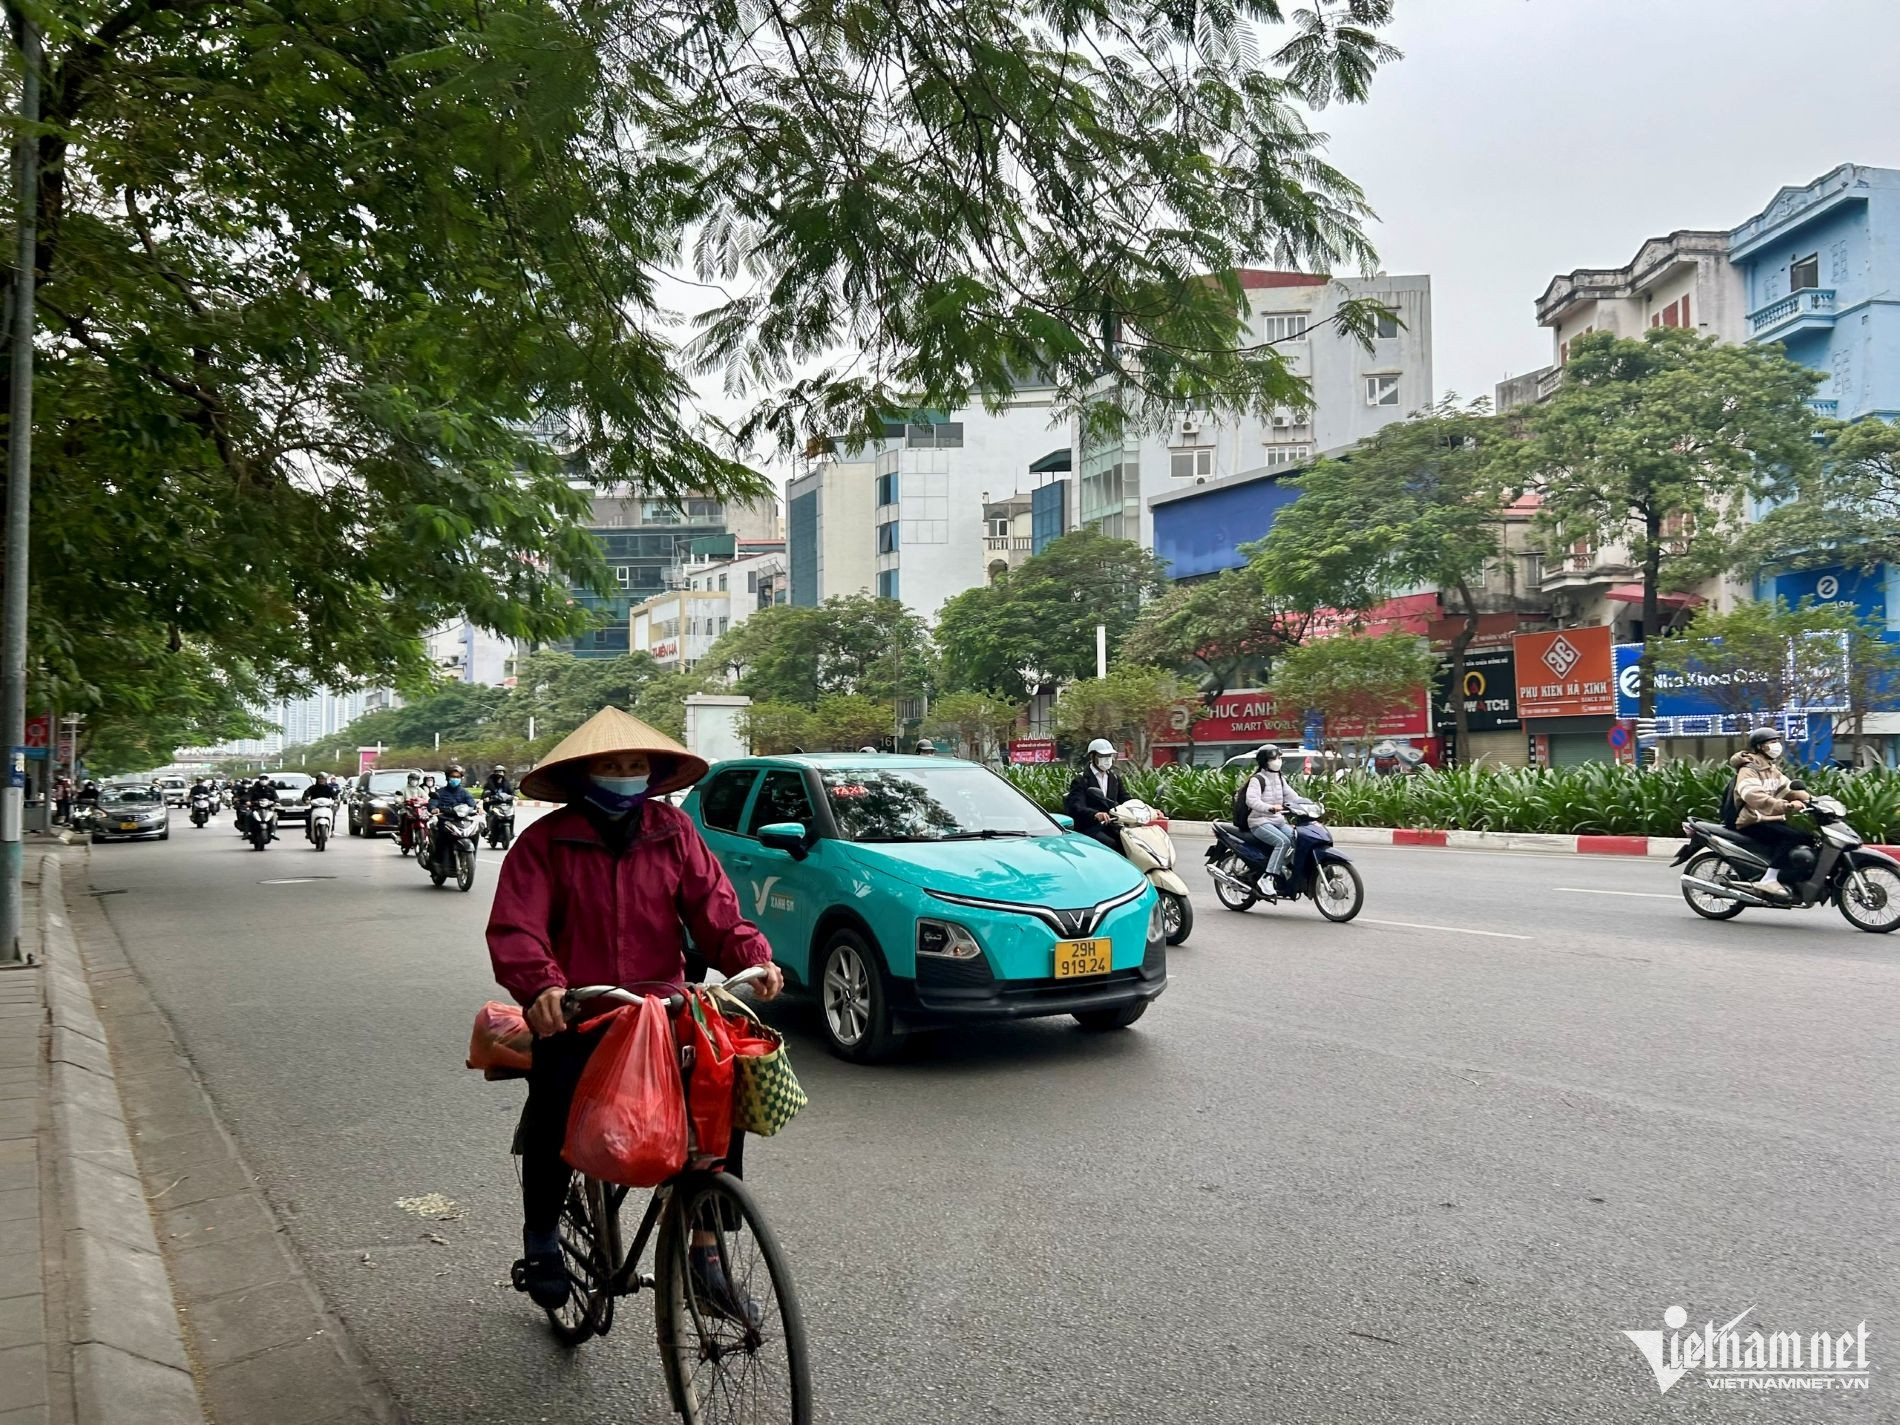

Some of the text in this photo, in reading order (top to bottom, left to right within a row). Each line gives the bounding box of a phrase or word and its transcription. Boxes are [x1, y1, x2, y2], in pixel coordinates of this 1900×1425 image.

[1243, 702, 1277, 718] ANH
[1231, 721, 1262, 732] SMART
[1071, 941, 1096, 958] 29H
[1061, 957, 1106, 976] 919.24
